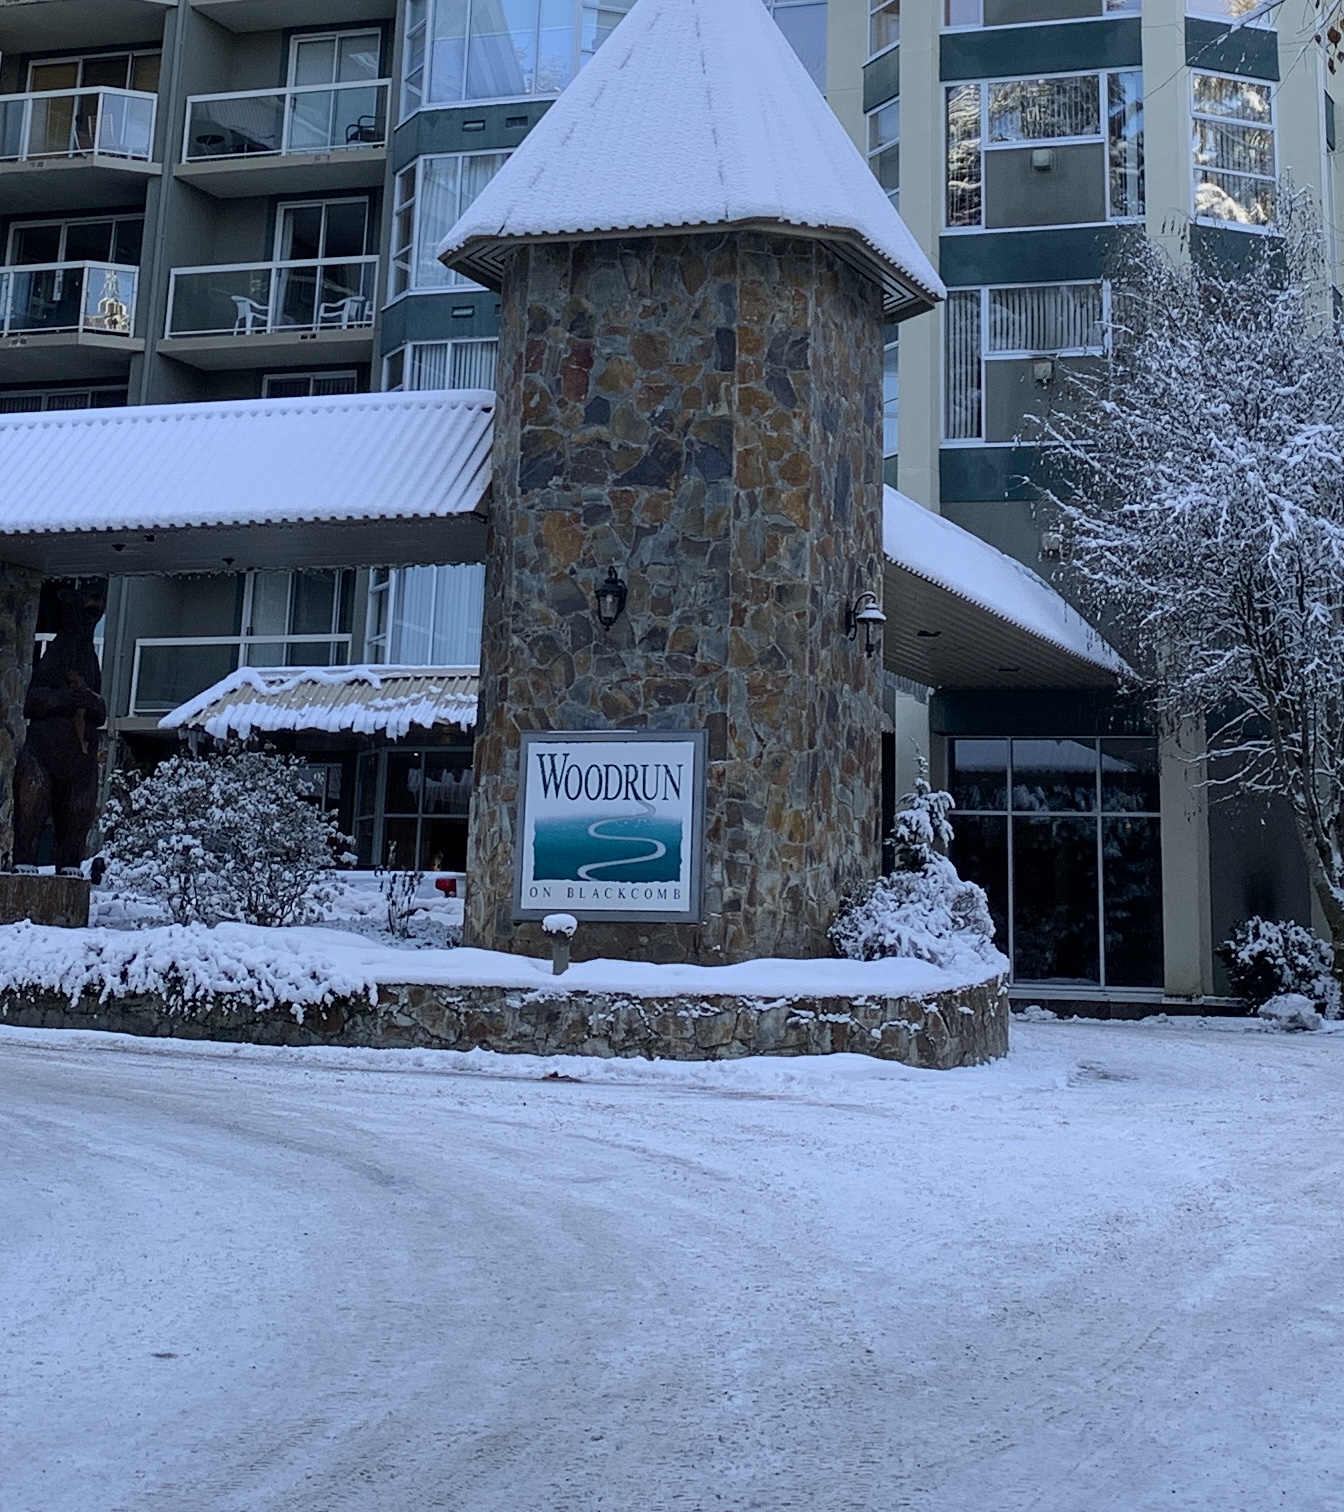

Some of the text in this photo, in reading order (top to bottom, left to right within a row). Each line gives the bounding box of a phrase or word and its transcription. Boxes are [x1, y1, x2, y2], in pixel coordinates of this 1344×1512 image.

[536, 753, 684, 801] WOODRUN
[529, 886, 681, 900] ON BLACKCOMB
